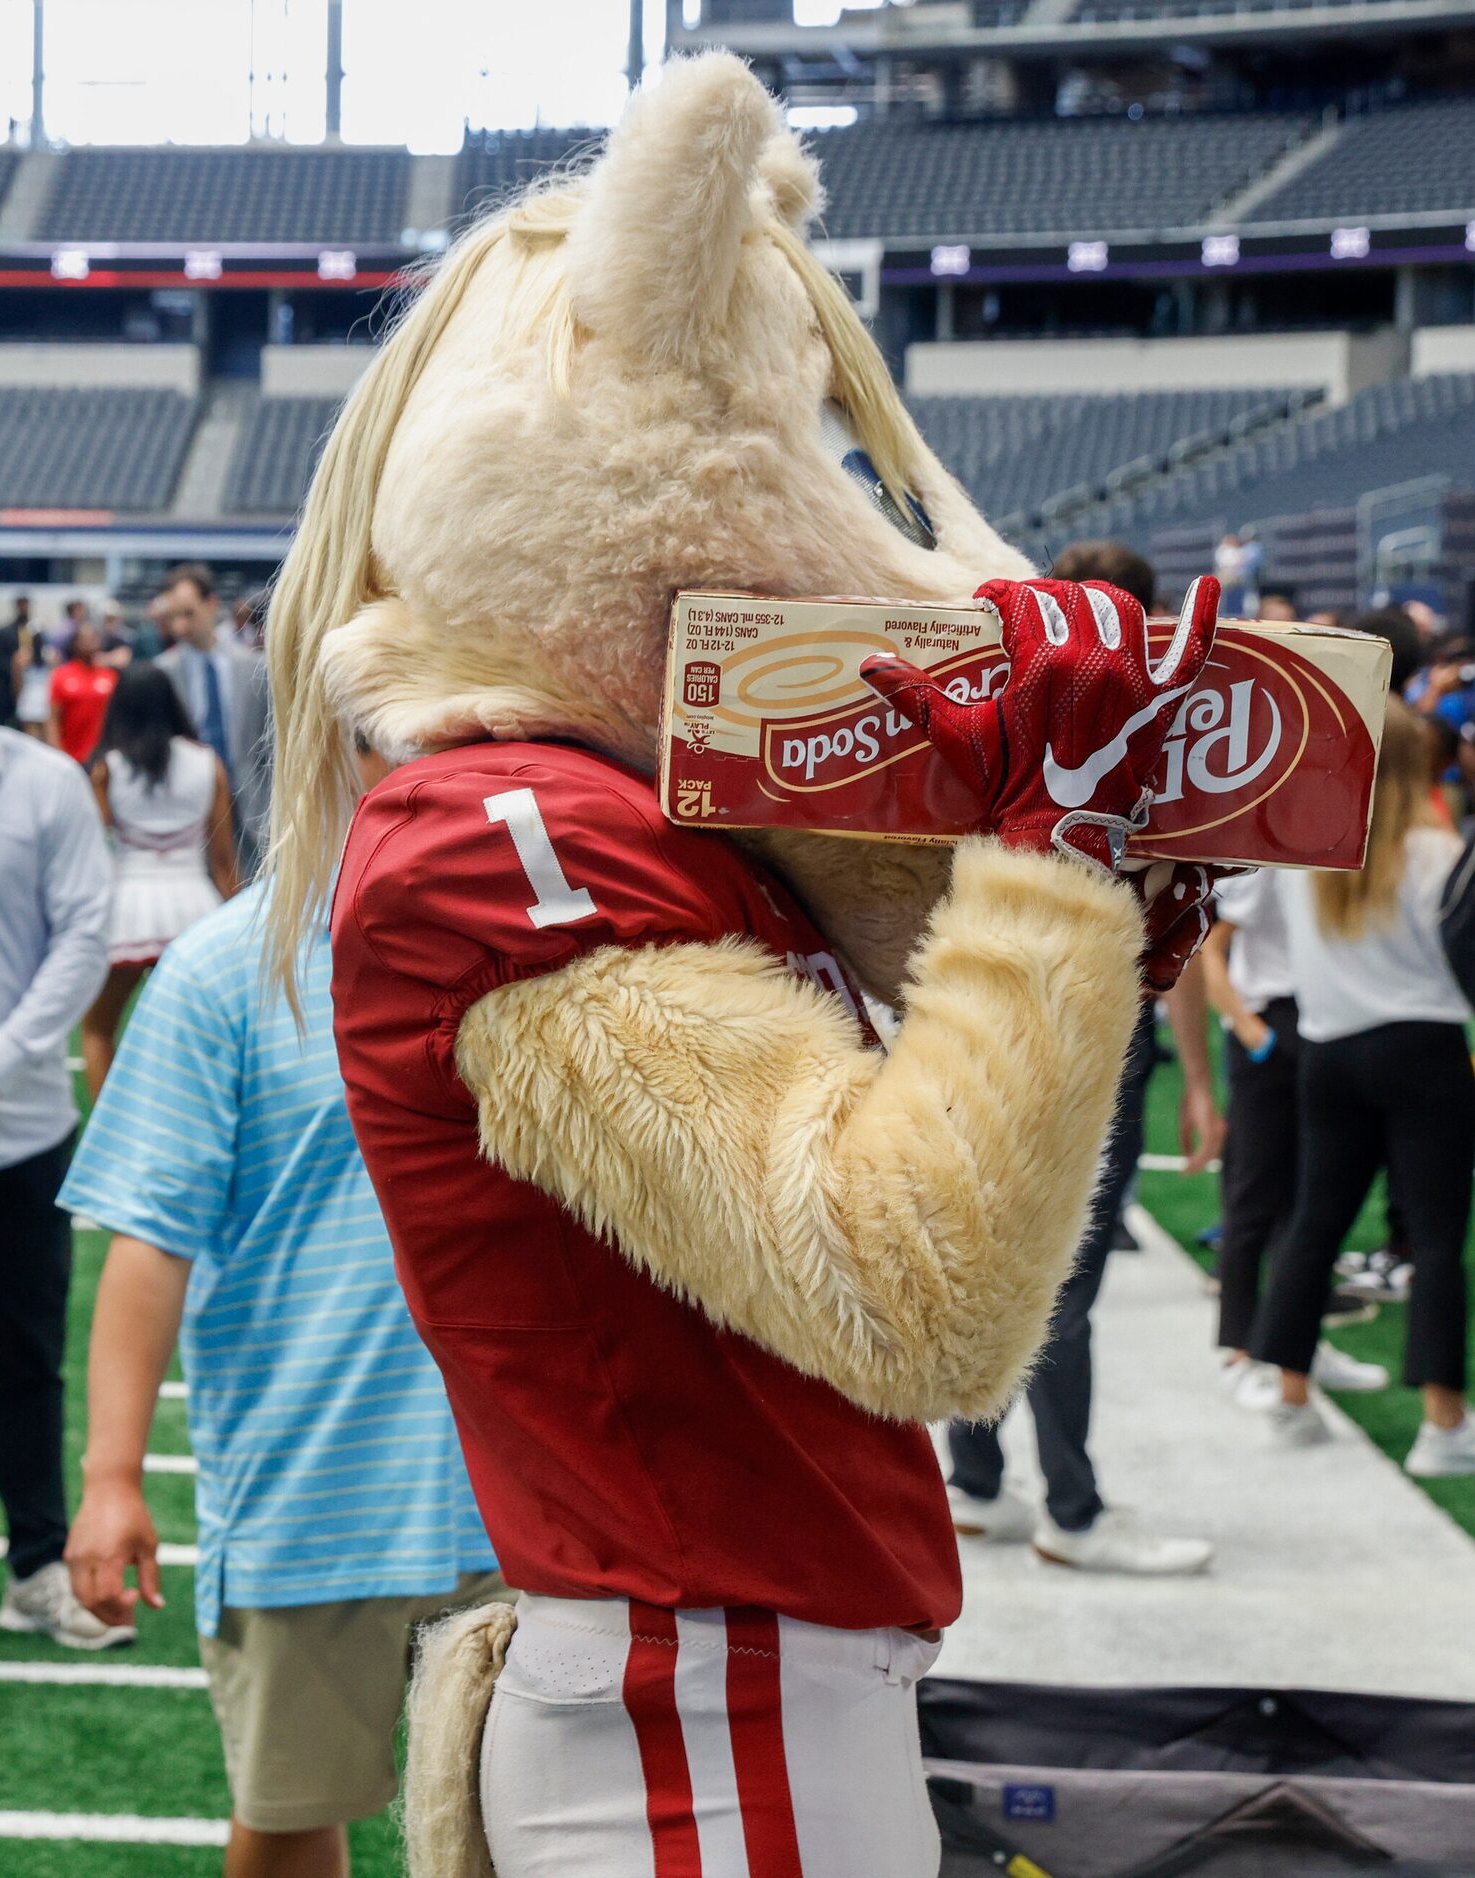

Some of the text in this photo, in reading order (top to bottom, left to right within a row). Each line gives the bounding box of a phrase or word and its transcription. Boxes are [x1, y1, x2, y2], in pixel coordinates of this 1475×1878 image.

[688, 607, 785, 626] 12-355 mL CANS (4.3 L)
[687, 622, 759, 639] CANS (144 FL OZ)
[884, 620, 982, 637] Artificially Flavored
[686, 638, 735, 651] 12-12 FL OZ
[904, 635, 960, 651] Naturally &
[686, 673, 719, 684] CALORIES
[690, 666, 702, 674] CAN
[687, 683, 716, 703] 150
[781, 715, 881, 781] Soda
[677, 779, 713, 791] PACK
[676, 789, 717, 818] 12
[482, 787, 599, 930] 1
